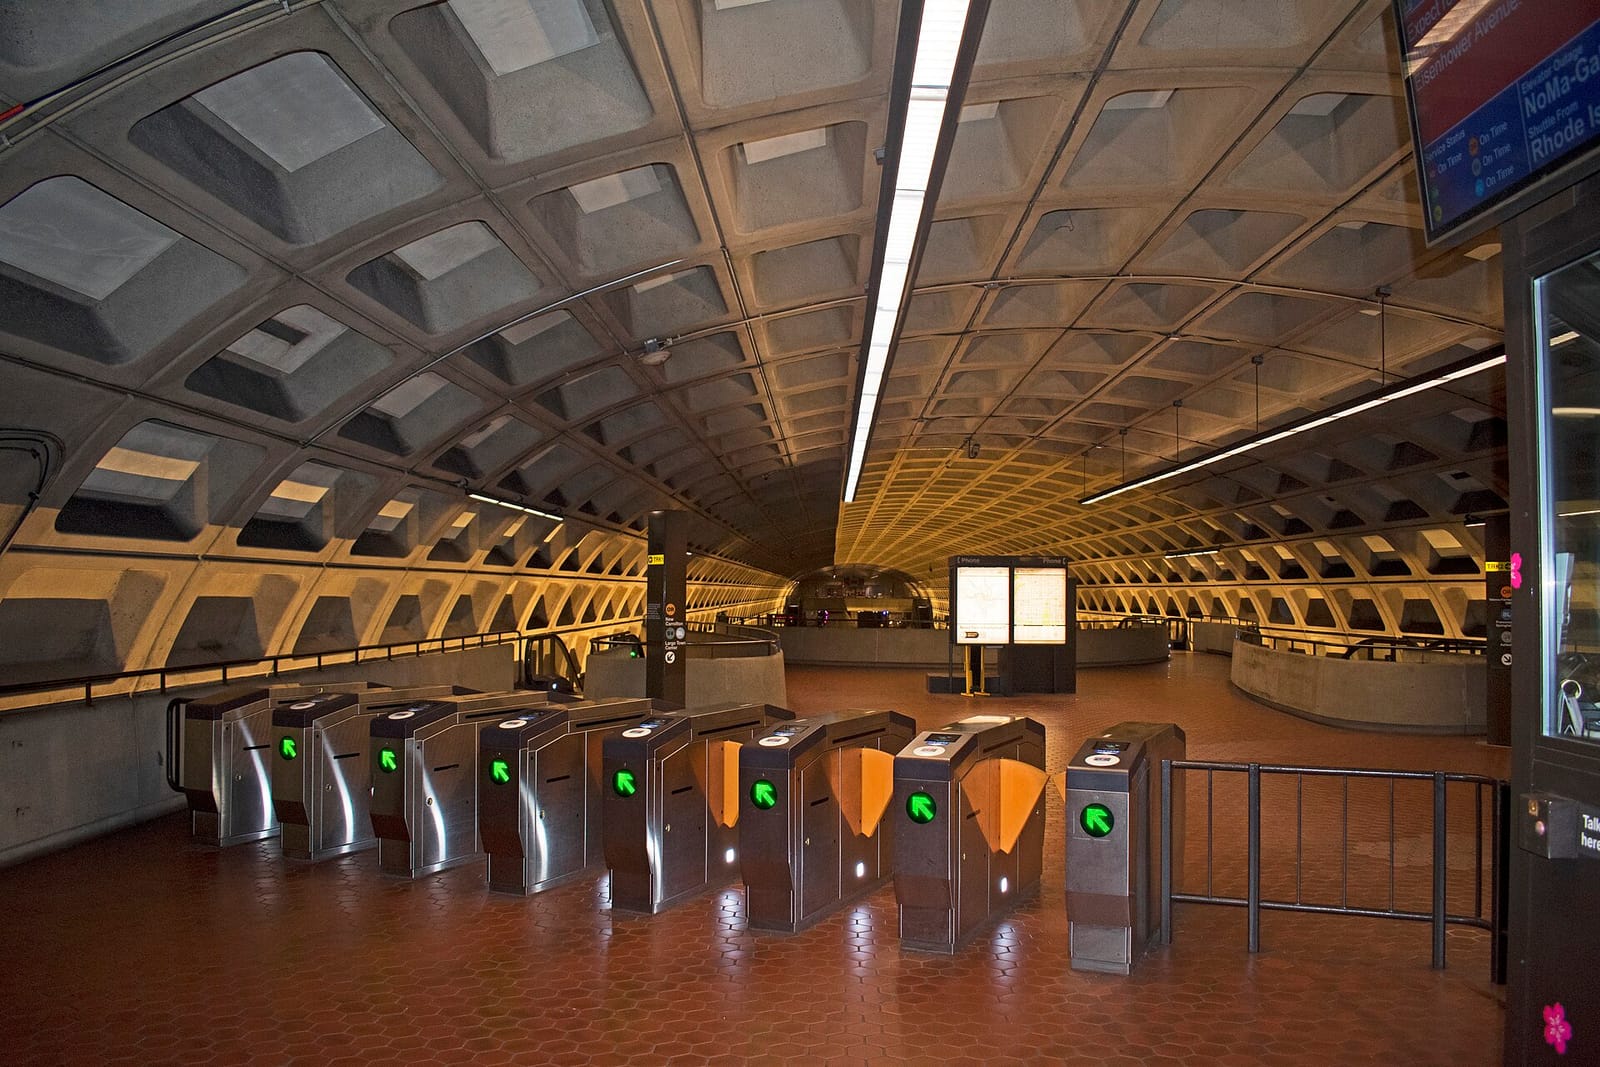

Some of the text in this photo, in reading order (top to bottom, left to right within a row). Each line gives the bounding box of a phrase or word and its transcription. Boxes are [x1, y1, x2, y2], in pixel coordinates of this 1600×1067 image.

[1414, 32, 1472, 92] Eisenhower
[1521, 66, 1552, 94] Elevator
[1524, 47, 1600, 118] NoMa-Ga
[1528, 101, 1579, 139] Shuttle From
[1446, 129, 1466, 148] Status
[1480, 121, 1508, 146] On Time
[1531, 117, 1584, 162] Rhode
[1438, 152, 1463, 175] On Time
[1482, 143, 1512, 167] On Time
[1486, 165, 1515, 188] On Time
